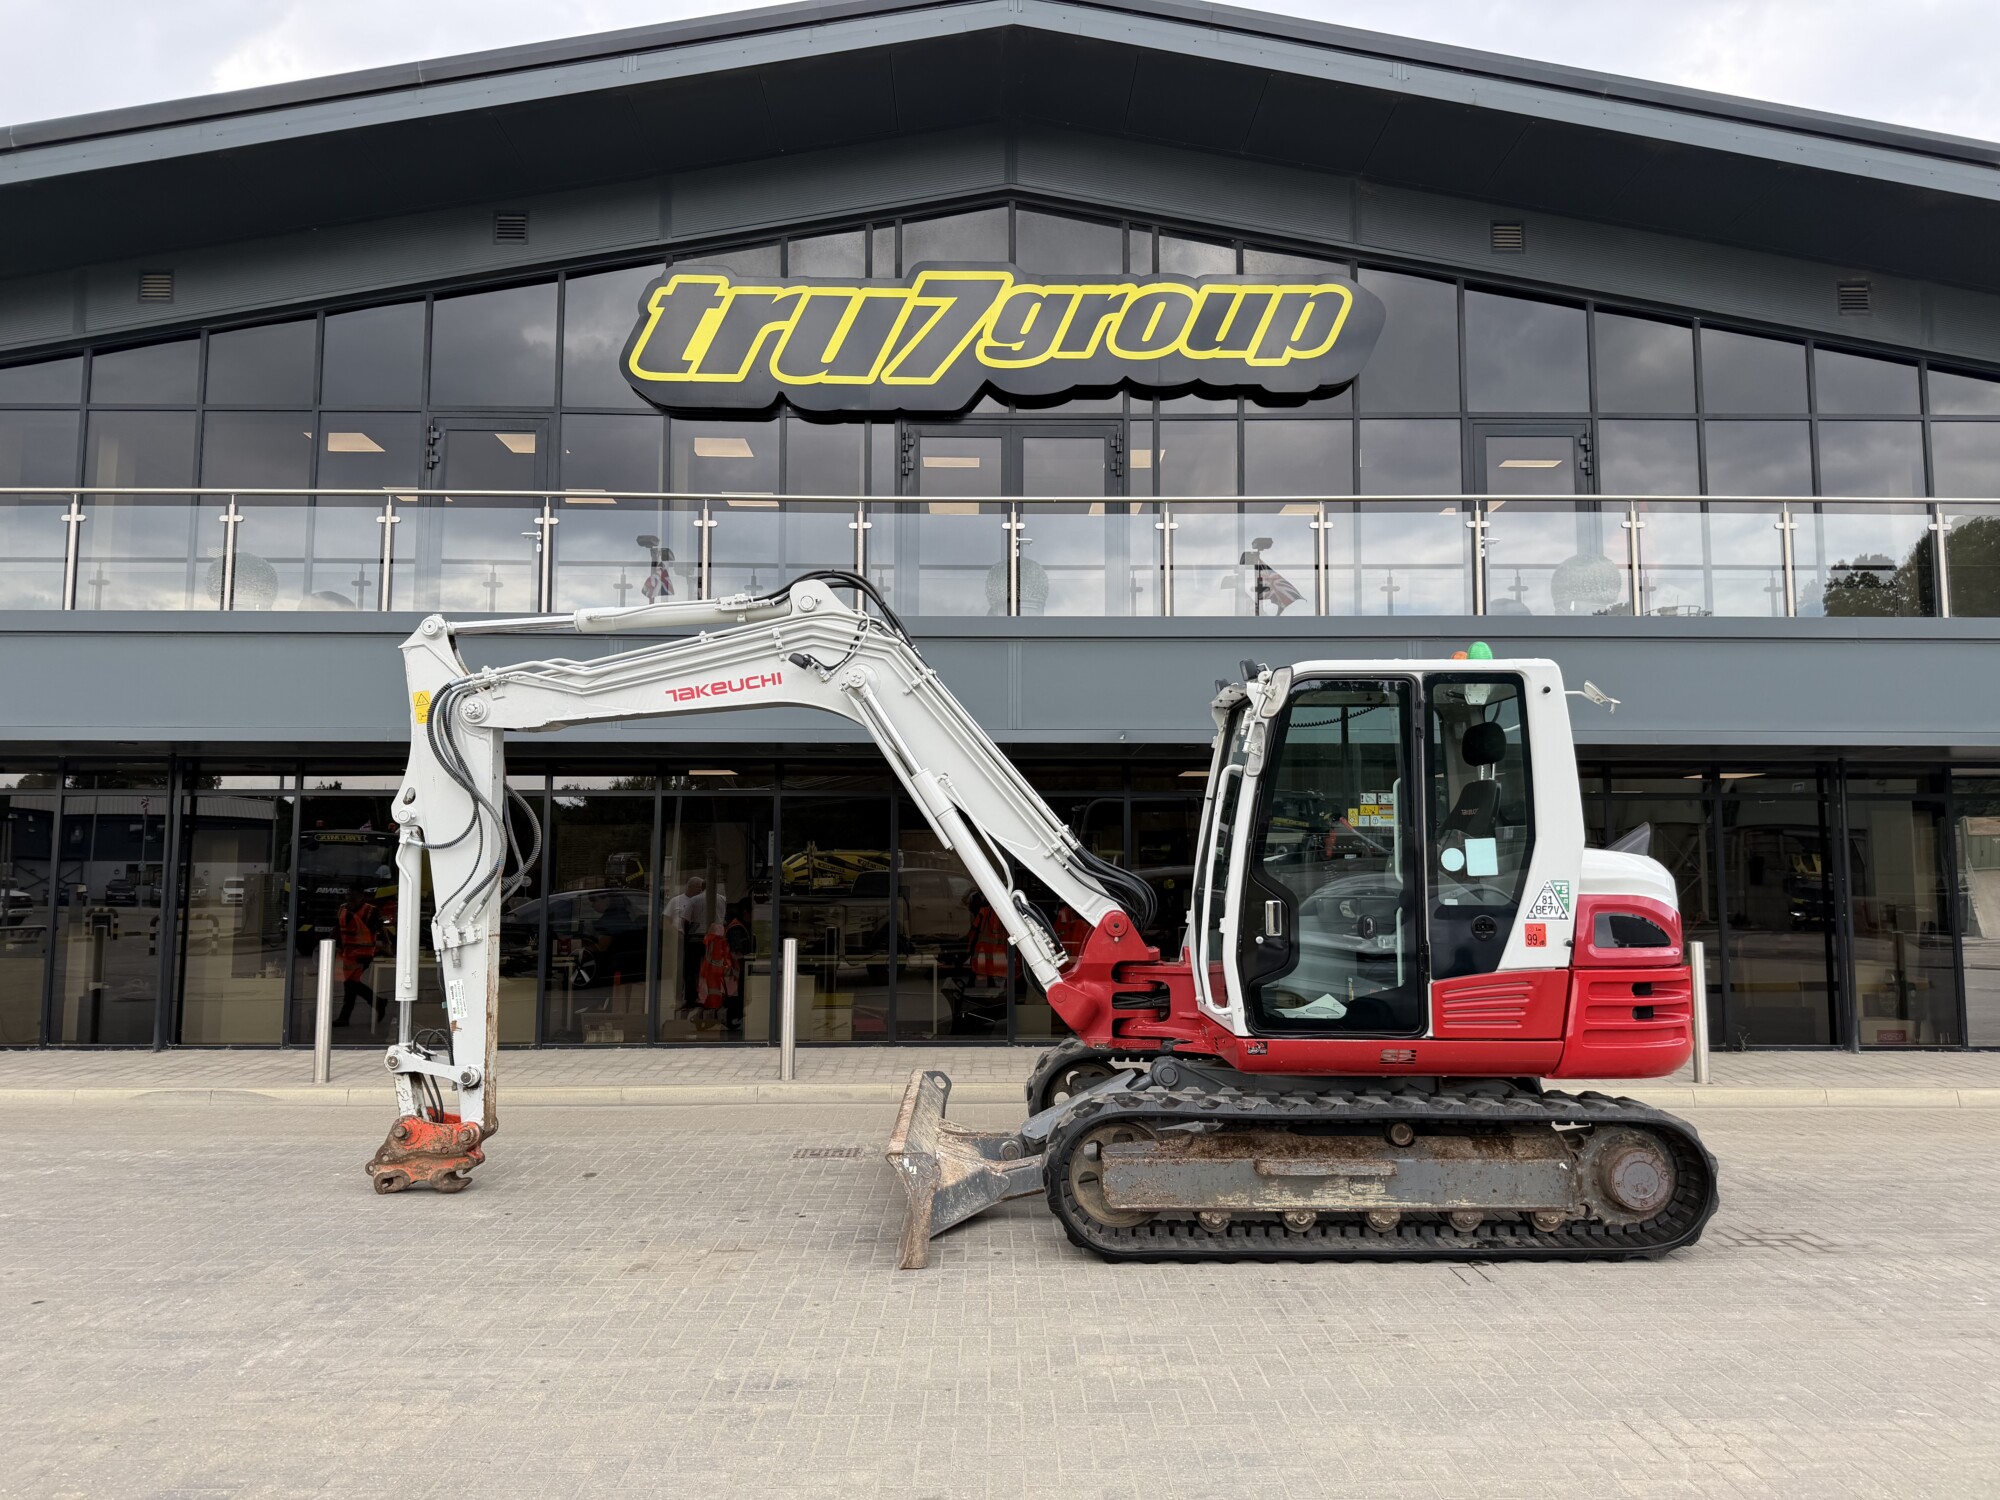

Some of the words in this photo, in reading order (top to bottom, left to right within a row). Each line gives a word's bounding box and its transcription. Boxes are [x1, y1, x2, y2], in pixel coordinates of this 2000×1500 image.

[665, 672, 783, 702] TAKEUCHI
[1542, 895, 1553, 905] 81
[1527, 933, 1538, 946] 99
